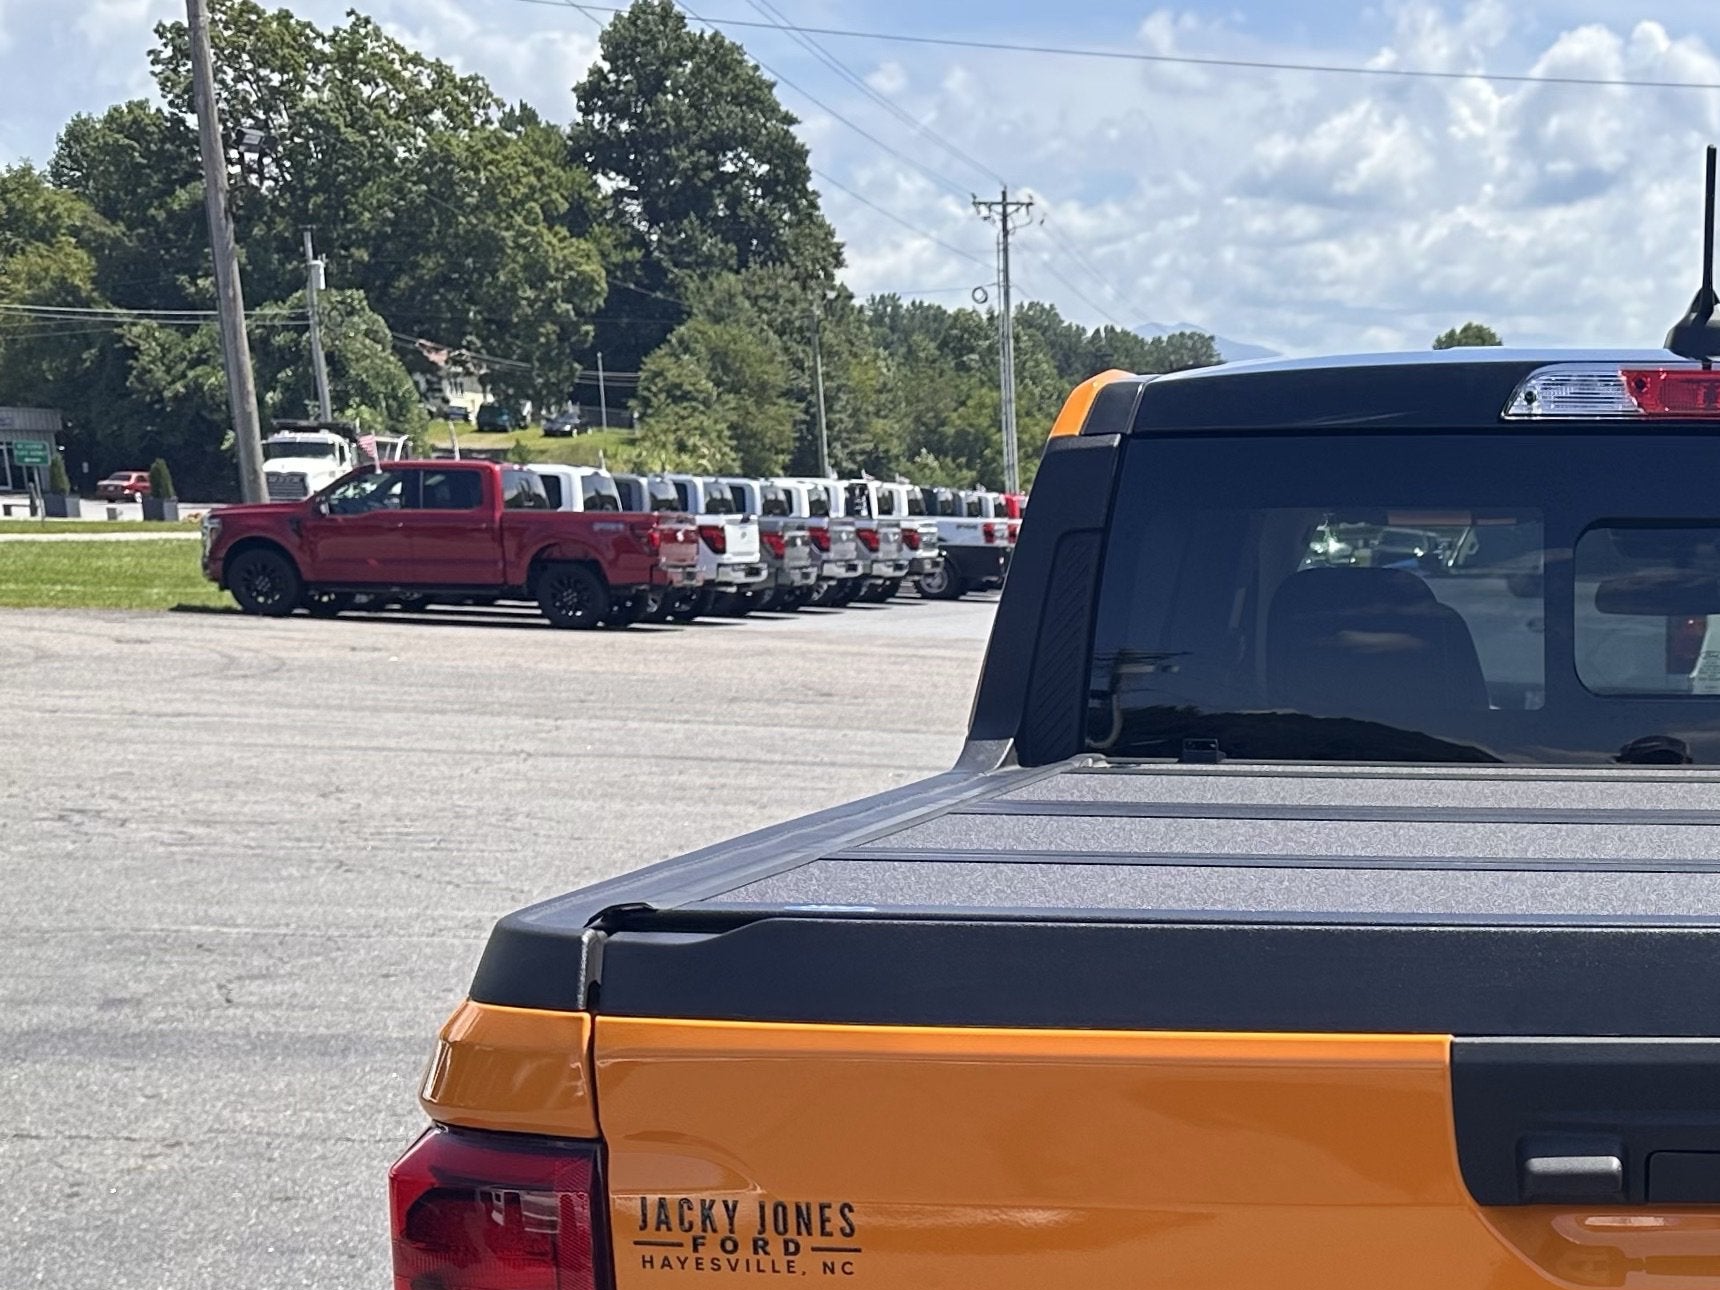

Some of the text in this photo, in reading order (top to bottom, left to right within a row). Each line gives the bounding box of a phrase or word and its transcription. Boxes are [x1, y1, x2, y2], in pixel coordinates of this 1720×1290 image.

[638, 1196, 857, 1238] JACKY JONES
[691, 1235, 802, 1257] FORD
[641, 1254, 856, 1276] HAYESVILLE, NC
